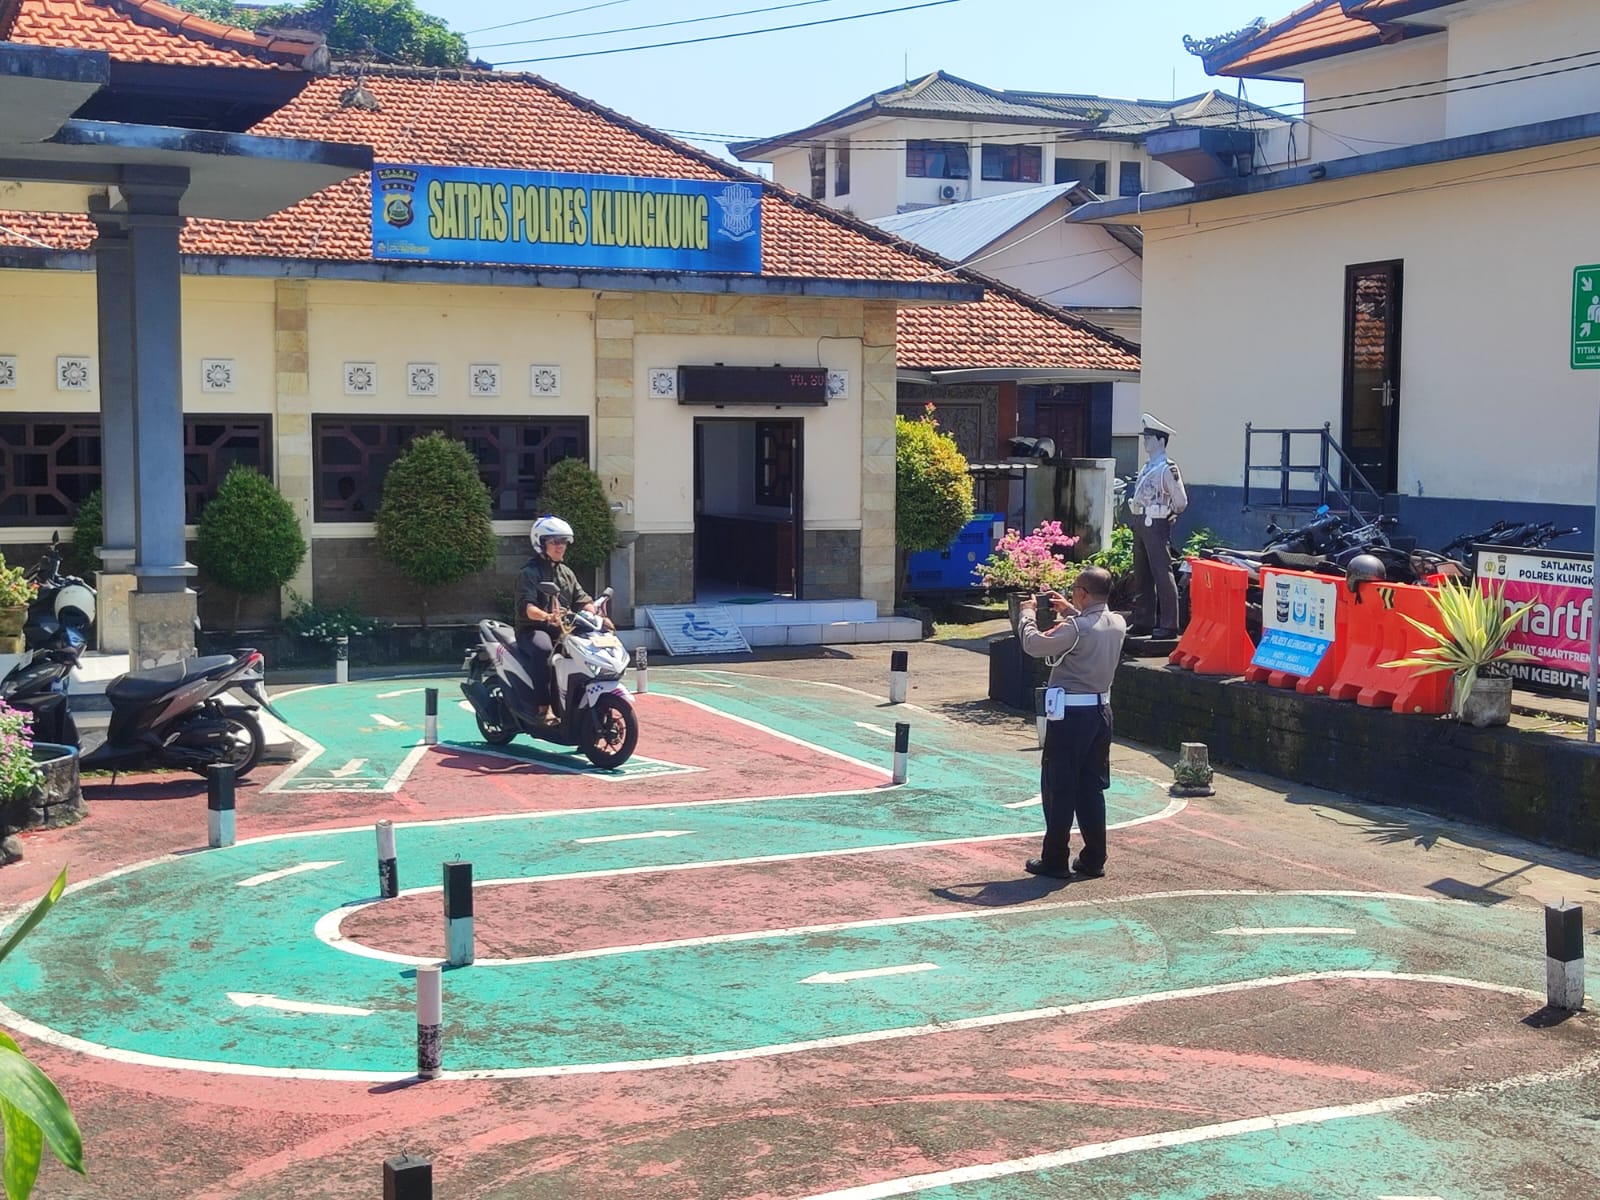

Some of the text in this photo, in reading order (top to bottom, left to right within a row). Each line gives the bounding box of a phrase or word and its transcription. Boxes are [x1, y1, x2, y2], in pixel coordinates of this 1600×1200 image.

[427, 179, 709, 251] SATPAS POLRES KLUNGKUNG
[1576, 346, 1596, 354] TITIK
[1519, 569, 1554, 581] POLRES
[1541, 560, 1592, 573] SATLANTAS
[1504, 597, 1593, 641] martf
[1531, 667, 1591, 690] KEBUT-K
